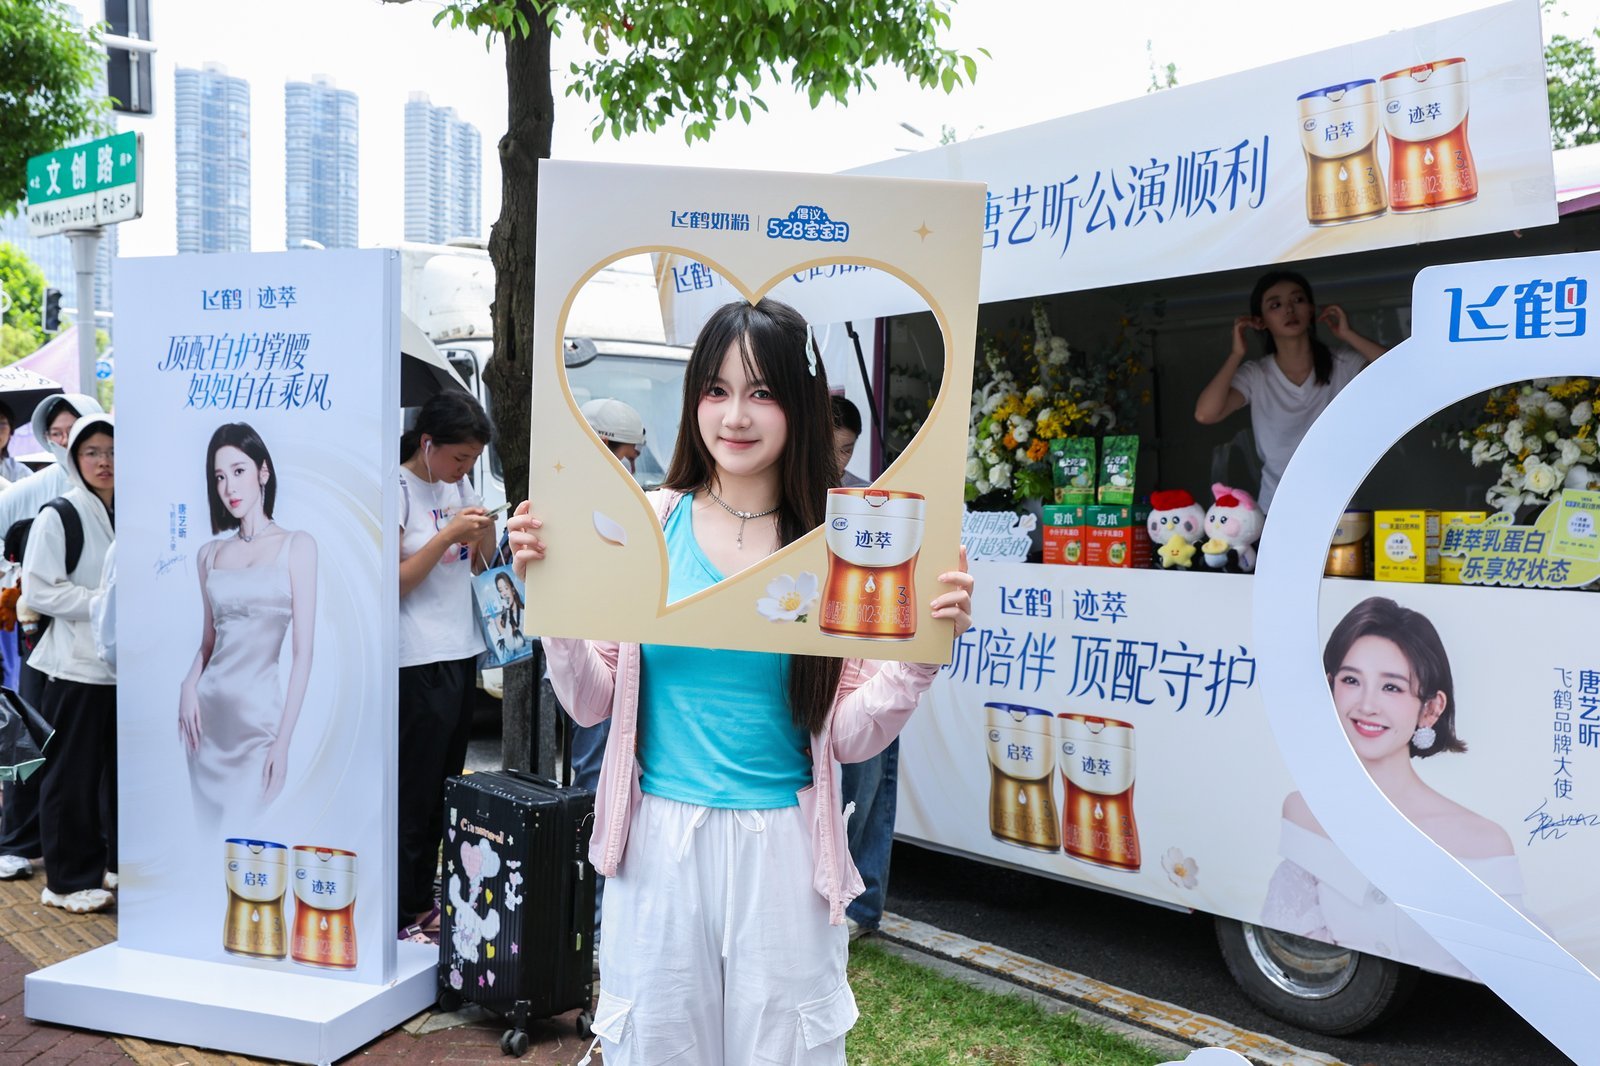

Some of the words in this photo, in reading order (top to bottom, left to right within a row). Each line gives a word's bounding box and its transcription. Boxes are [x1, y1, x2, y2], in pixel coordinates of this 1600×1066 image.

[1408, 102, 1443, 125] 迹萃
[1324, 121, 1355, 143] 启萃
[46, 143, 114, 196] 文创路
[983, 134, 1270, 260] 唐艺昕公演顺利
[670, 210, 750, 232] 飞鹤奶粉
[797, 207, 822, 221] 倡议
[671, 262, 714, 293] 飞鹤
[201, 288, 242, 311] 飞鹤
[257, 285, 297, 309] 迹萃
[1444, 276, 1588, 343] 飞鹤
[158, 332, 312, 372] 顶配自护撑腰
[183, 372, 332, 412] 妈妈自在乘风
[855, 530, 892, 549] 迹萃
[1442, 528, 1546, 554] 鲜萃乳蛋白
[1462, 556, 1572, 583] 乐享好状态
[897, 586, 908, 605] 3
[999, 586, 1052, 618] 飞鹤
[1073, 589, 1129, 624] 迹萃
[1066, 633, 1257, 718] 顶配守护
[1578, 669, 1600, 748] 唐艺昕
[1553, 667, 1572, 800] 飞鹤品牌大使
[1007, 743, 1033, 762] 启萃
[1082, 756, 1112, 777] 迹萃
[244, 872, 268, 886] 启萃
[312, 880, 336, 894] 迹萃
